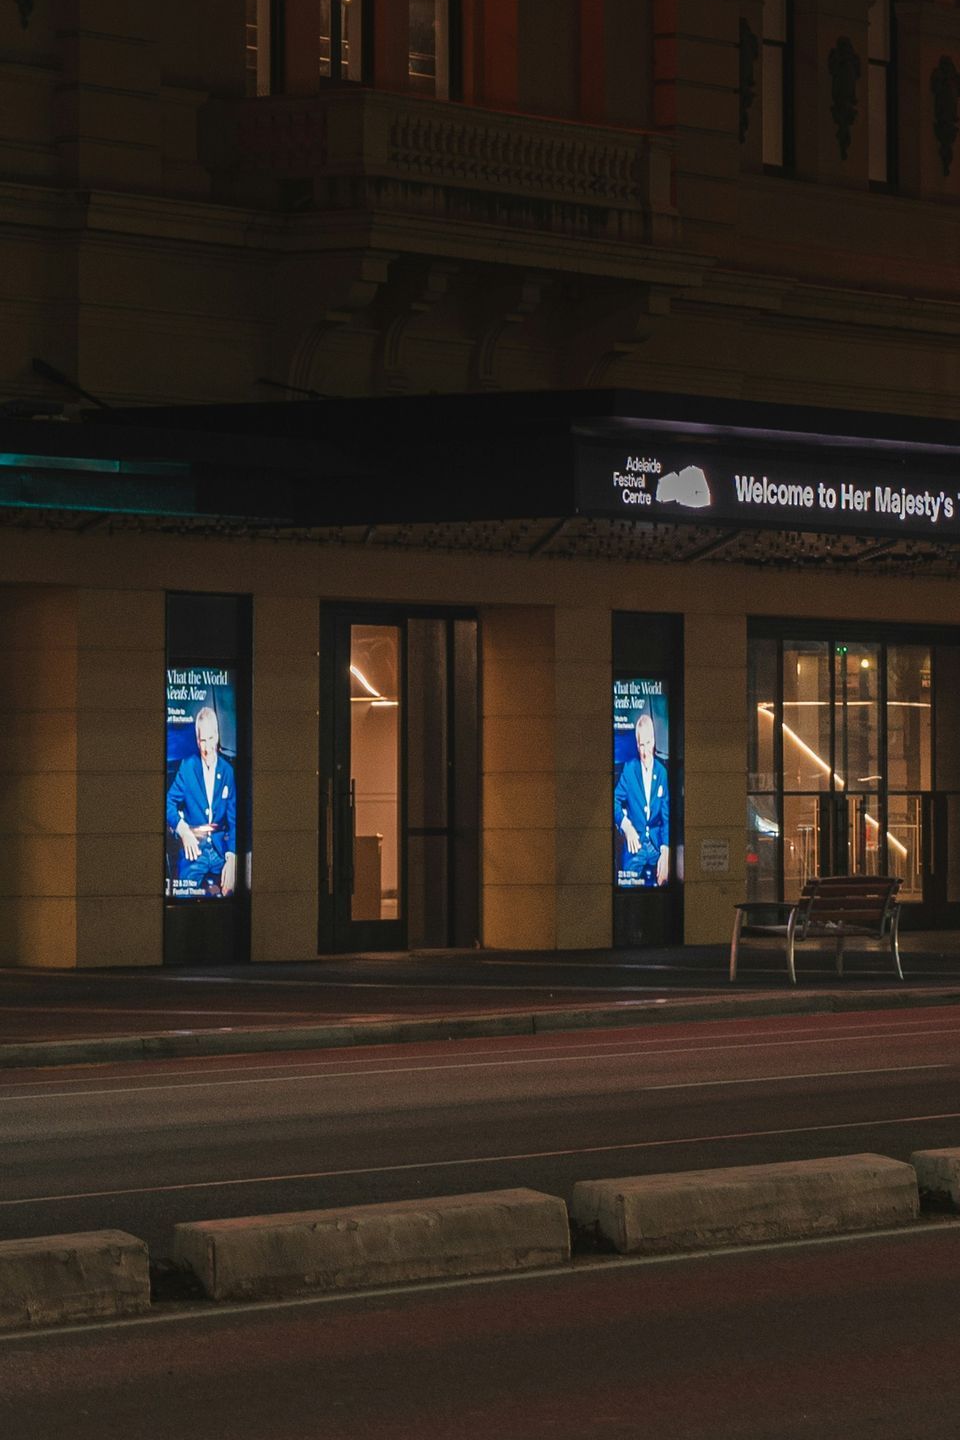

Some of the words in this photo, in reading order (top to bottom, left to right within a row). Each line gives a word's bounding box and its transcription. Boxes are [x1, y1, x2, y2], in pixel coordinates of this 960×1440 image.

[626, 456, 661, 473] Adelaide
[613, 472, 645, 488] Festival
[622, 489, 651, 505] Centre
[735, 475, 813, 507] Welcome
[818, 483, 836, 509] to
[841, 483, 871, 511] Her
[875, 486, 953, 523] Majesty's
[188, 671, 201, 684] the
[202, 670, 228, 685] World
[641, 681, 662, 695] World
